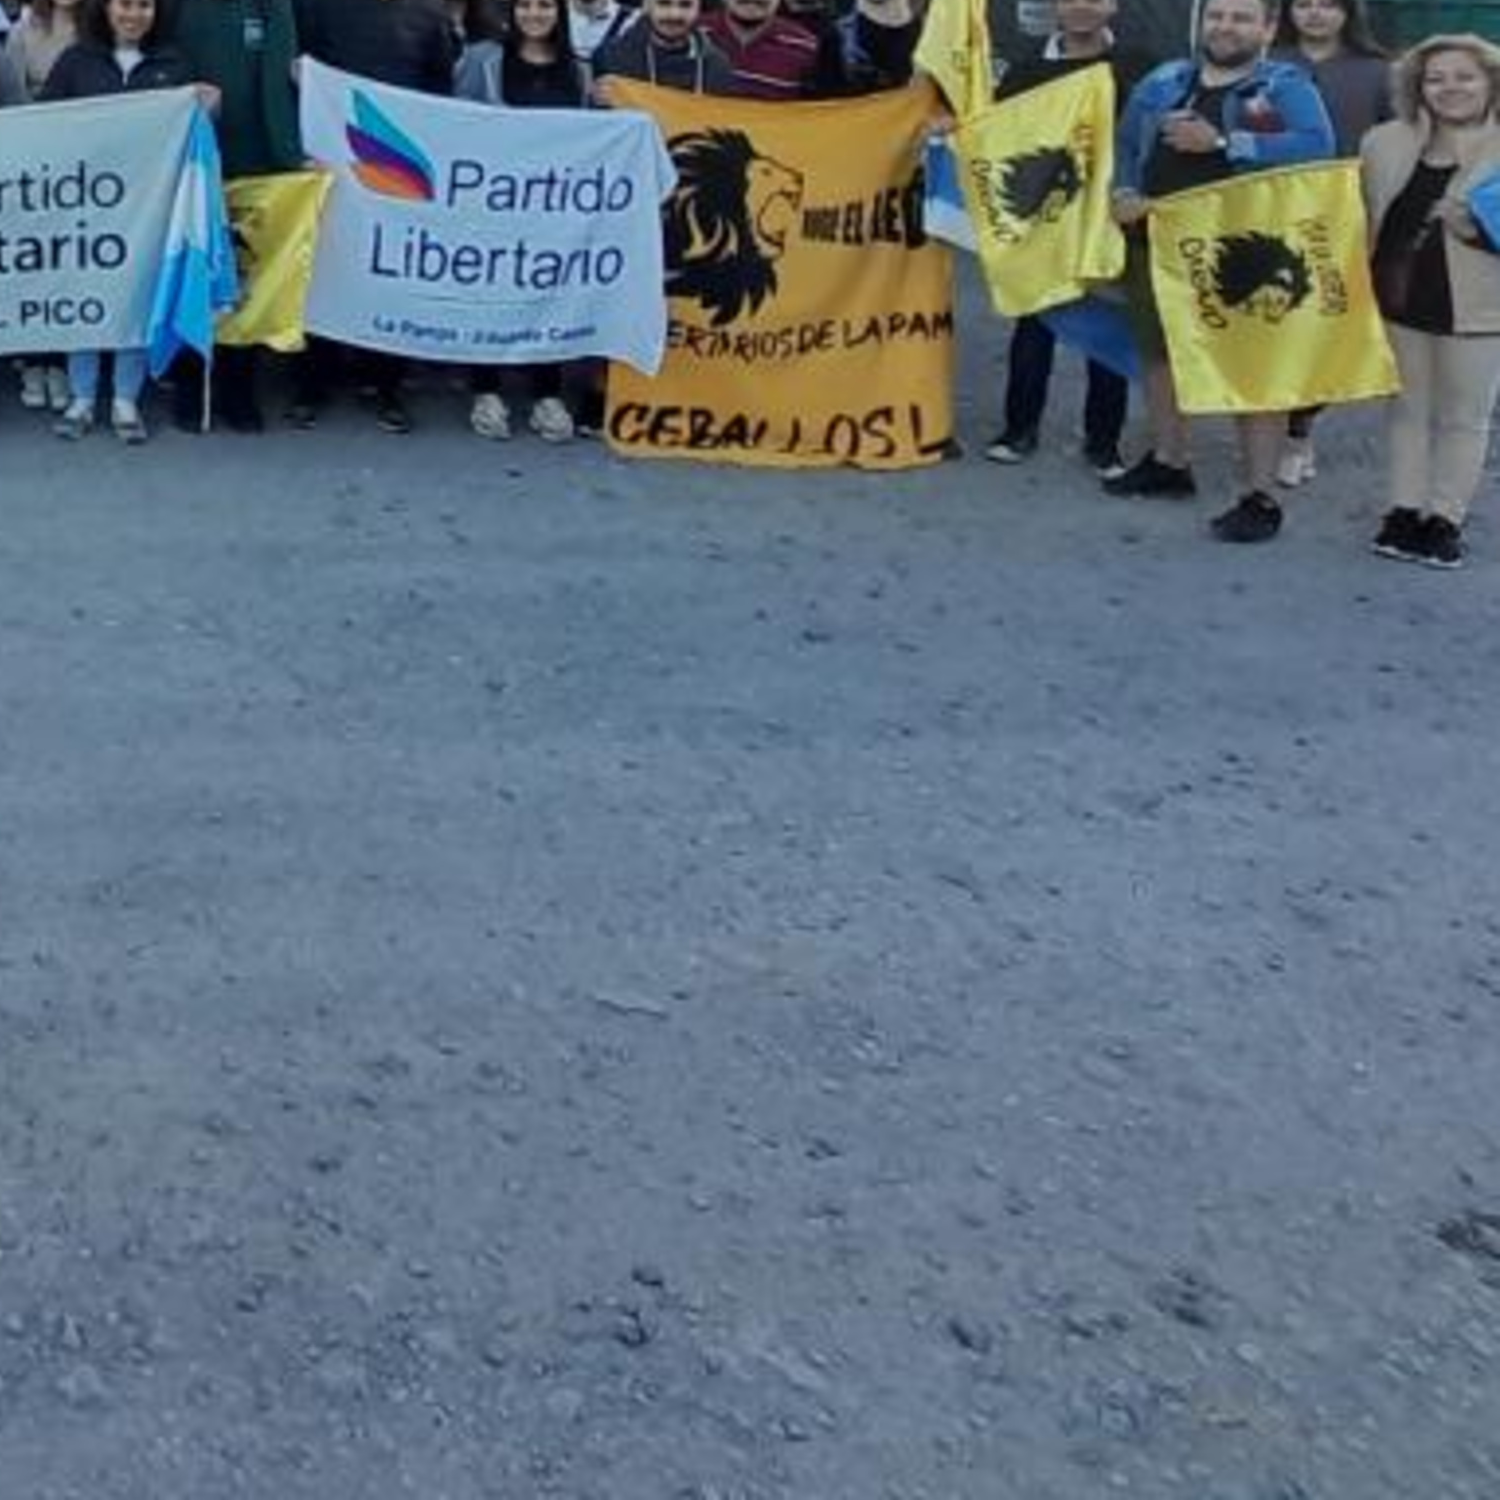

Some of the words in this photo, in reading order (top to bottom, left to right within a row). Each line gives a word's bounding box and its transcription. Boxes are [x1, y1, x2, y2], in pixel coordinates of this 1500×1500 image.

[447, 159, 633, 213] Partido
[370, 224, 624, 290] Libertario
[19, 299, 105, 328] PICO
[799, 319, 835, 354] DE
